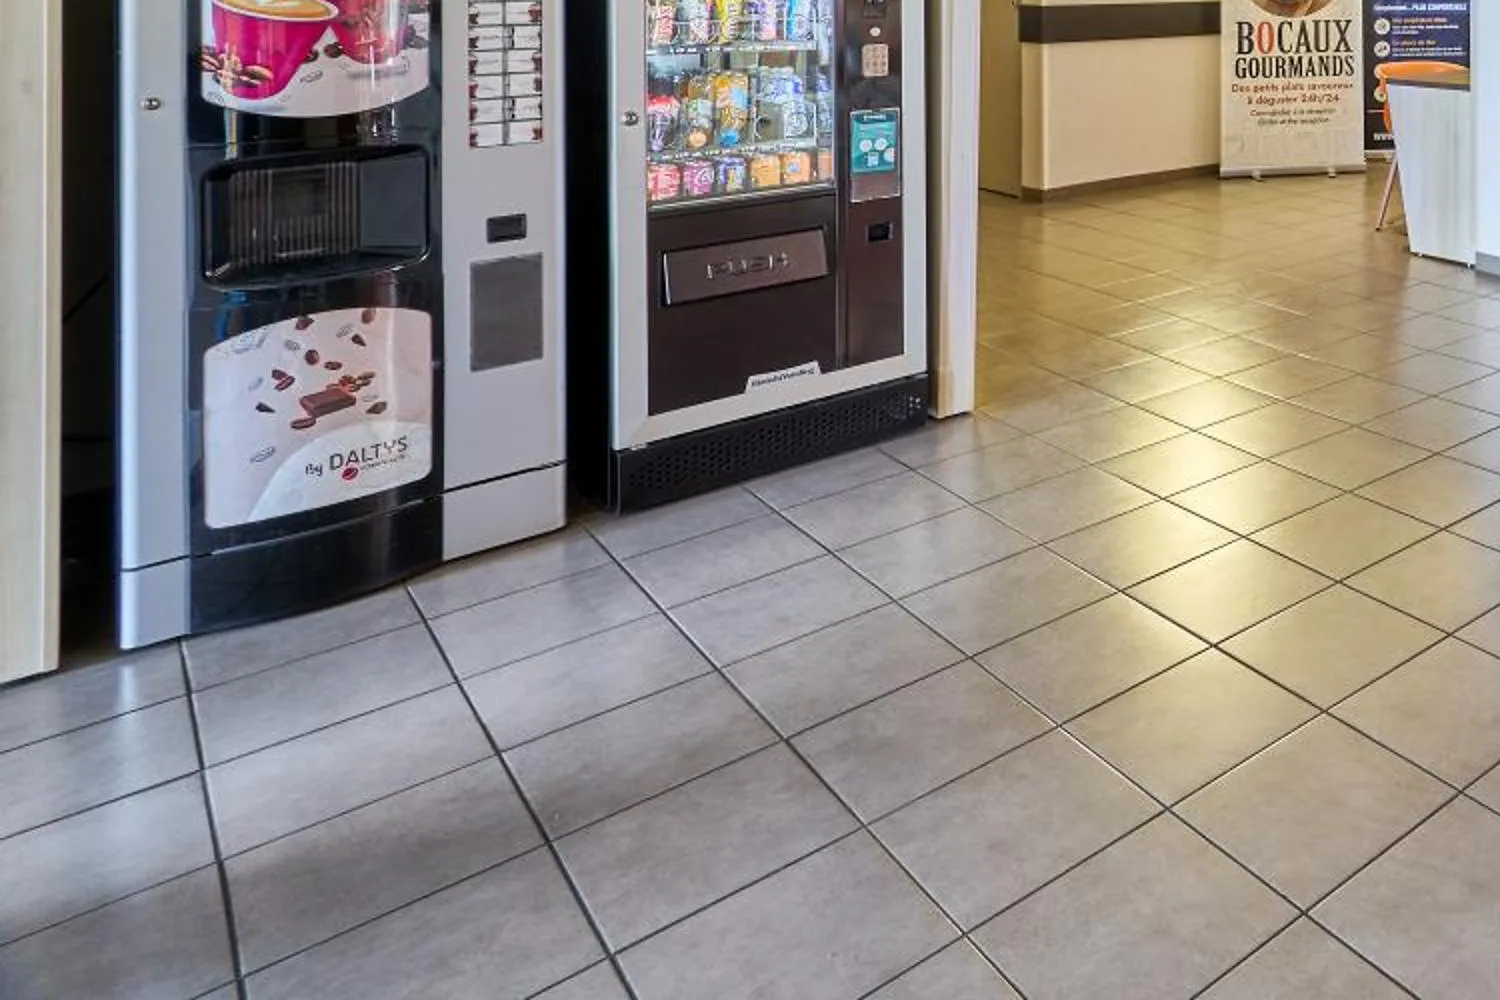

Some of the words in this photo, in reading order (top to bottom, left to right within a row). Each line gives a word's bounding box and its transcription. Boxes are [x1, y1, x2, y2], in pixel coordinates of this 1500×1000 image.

[1235, 19, 1354, 55] BOCAUX
[1235, 55, 1355, 79] GOURMANDS
[1231, 83, 1250, 93] Des
[705, 251, 789, 280] PUSH
[328, 435, 408, 471] DALTYS
